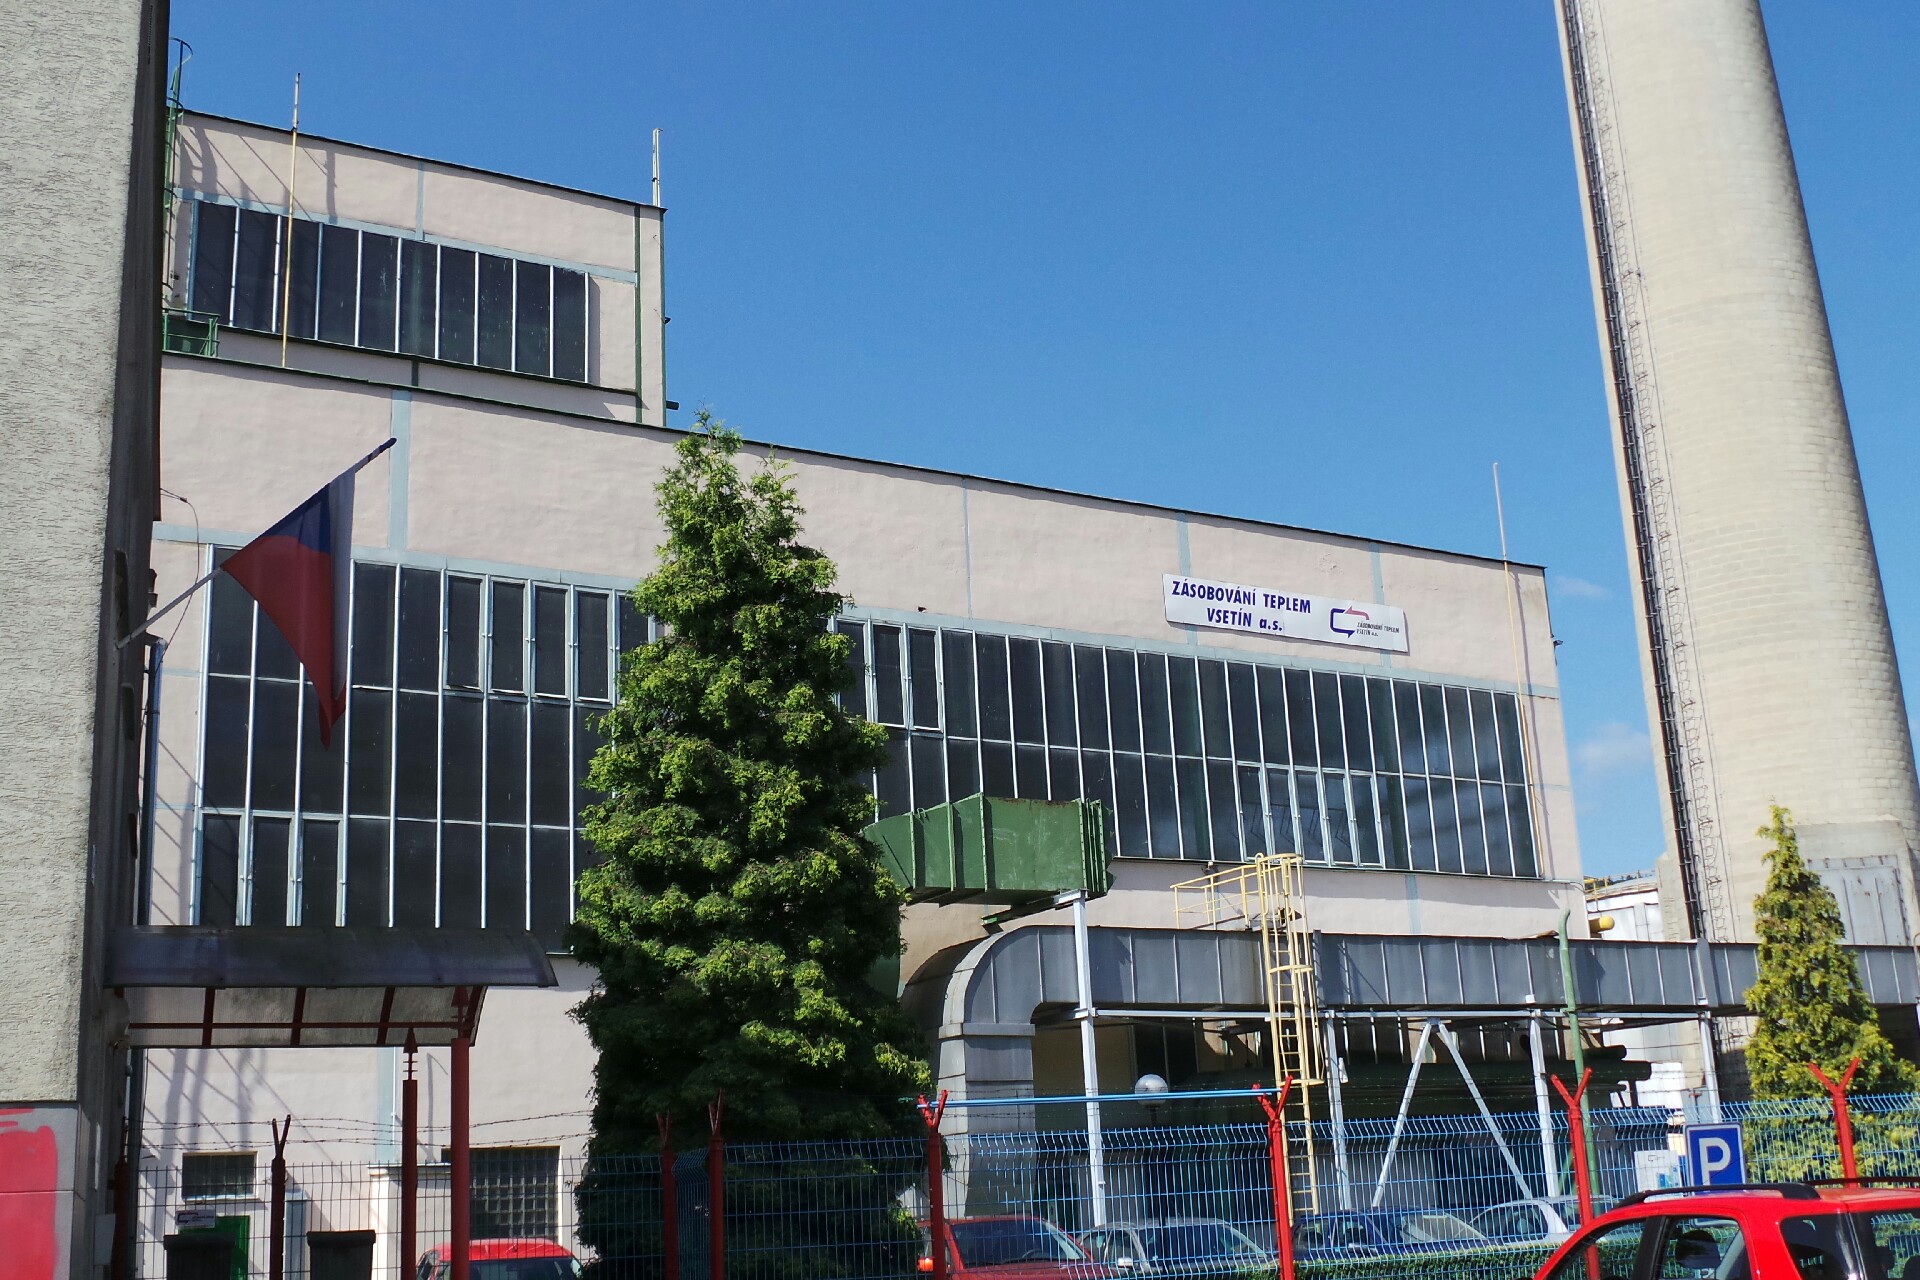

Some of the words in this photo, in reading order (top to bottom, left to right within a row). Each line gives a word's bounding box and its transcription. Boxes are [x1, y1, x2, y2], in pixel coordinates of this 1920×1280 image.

[1172, 578, 1256, 606] ZÁSOBOVÁNÍ
[1263, 593, 1311, 613] TEPLEM
[1207, 607, 1252, 627] VSETÍN
[1259, 618, 1283, 632] a.s.
[1698, 1137, 1731, 1186] P
